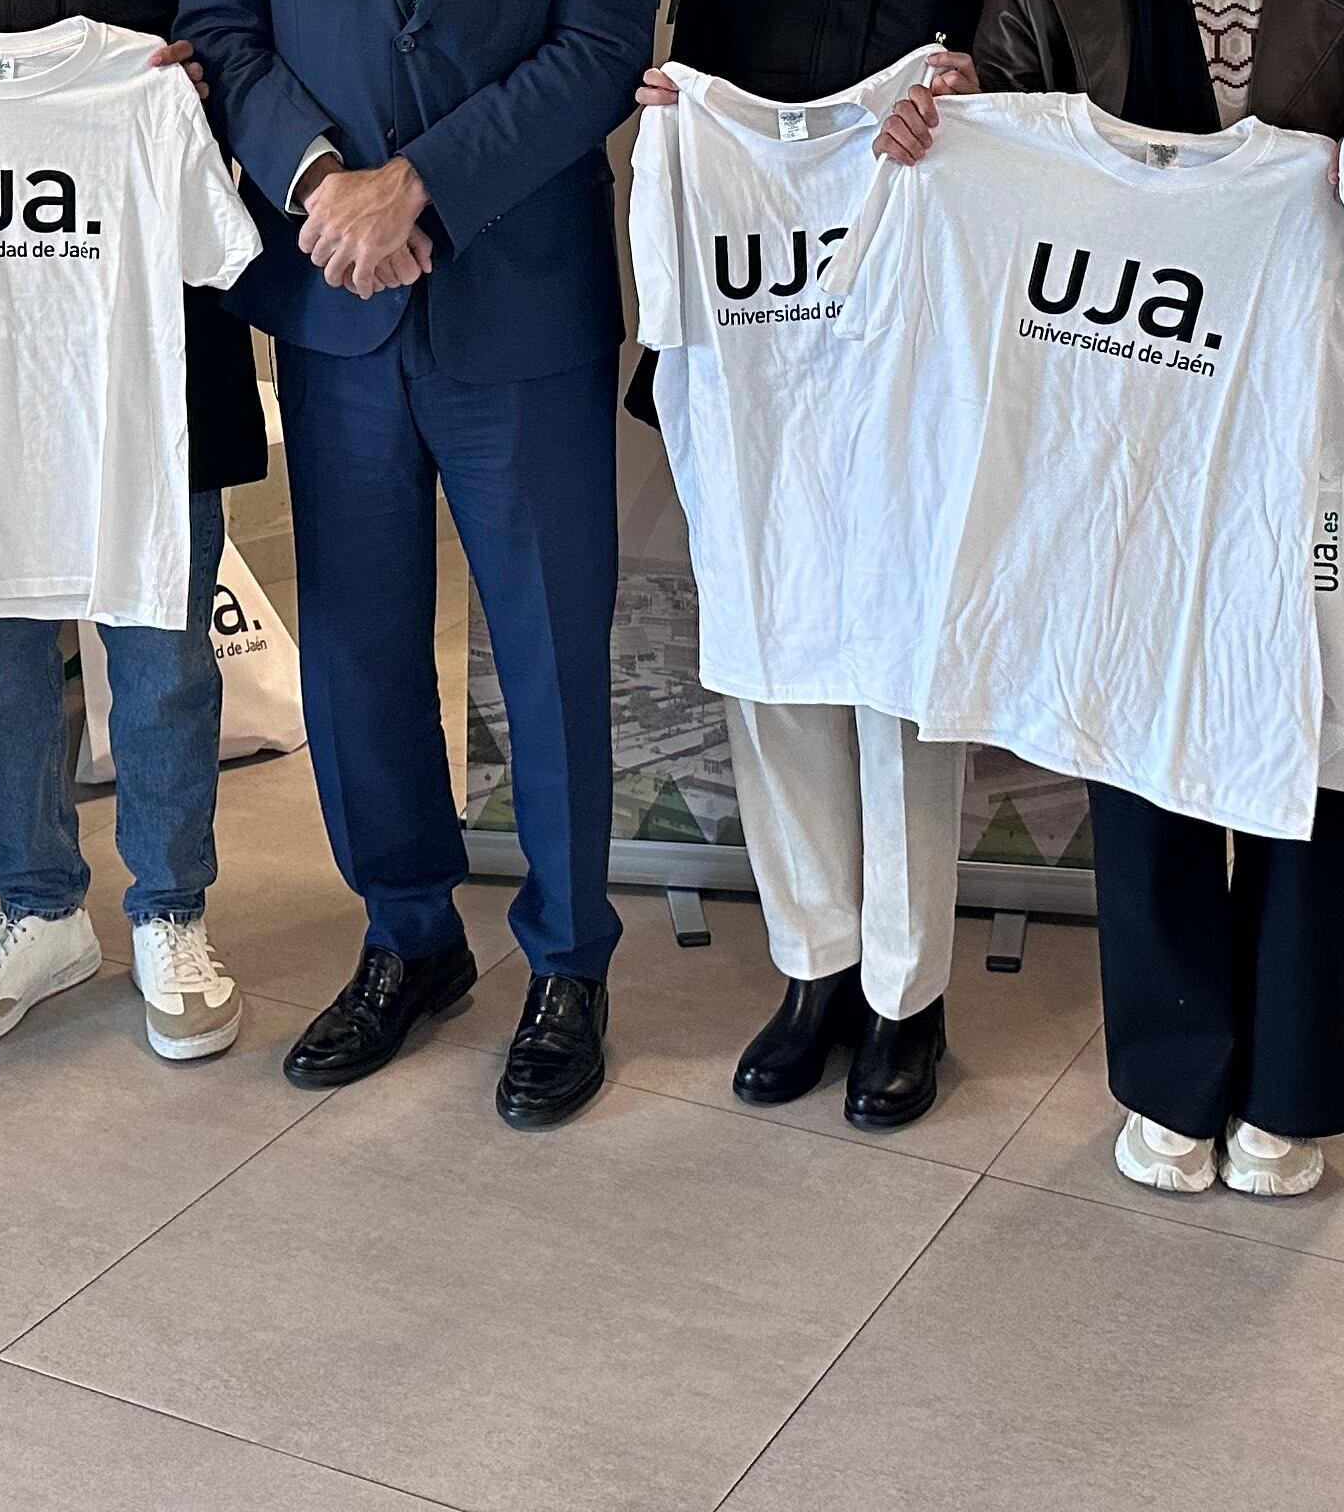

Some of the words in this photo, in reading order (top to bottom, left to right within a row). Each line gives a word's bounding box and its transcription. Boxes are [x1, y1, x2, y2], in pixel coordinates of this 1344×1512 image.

[32, 241, 55, 258] de
[58, 241, 101, 260] Jaén
[717, 301, 821, 327] Universidad
[1018, 318, 1135, 359] Universidad
[1138, 344, 1163, 365] de
[1166, 349, 1216, 378] Jaén
[226, 641, 243, 657] de
